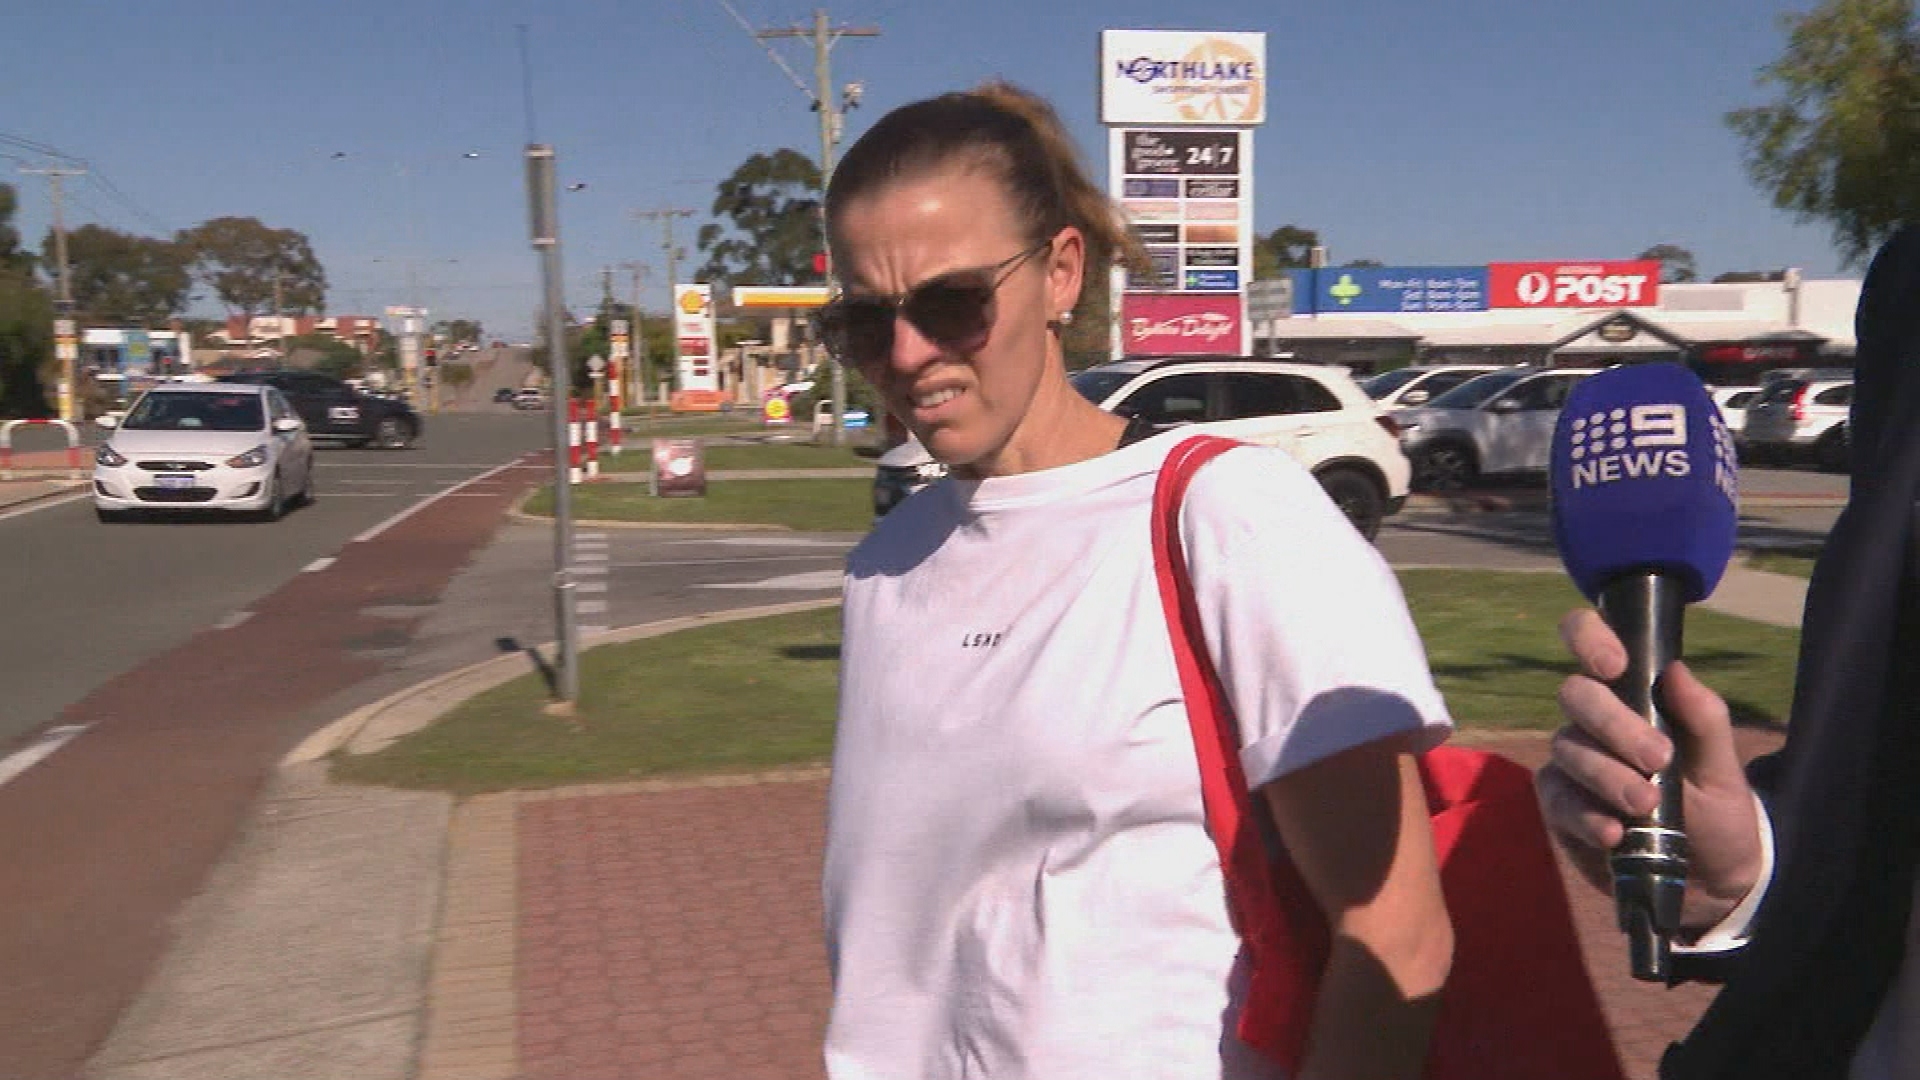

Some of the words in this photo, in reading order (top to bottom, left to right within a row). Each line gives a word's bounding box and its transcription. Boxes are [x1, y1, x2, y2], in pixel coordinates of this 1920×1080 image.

[1116, 56, 1255, 83] NORTHLAKE
[1554, 275, 1648, 303] POST
[1630, 403, 1688, 447] 9
[1571, 449, 1692, 489] NEWS
